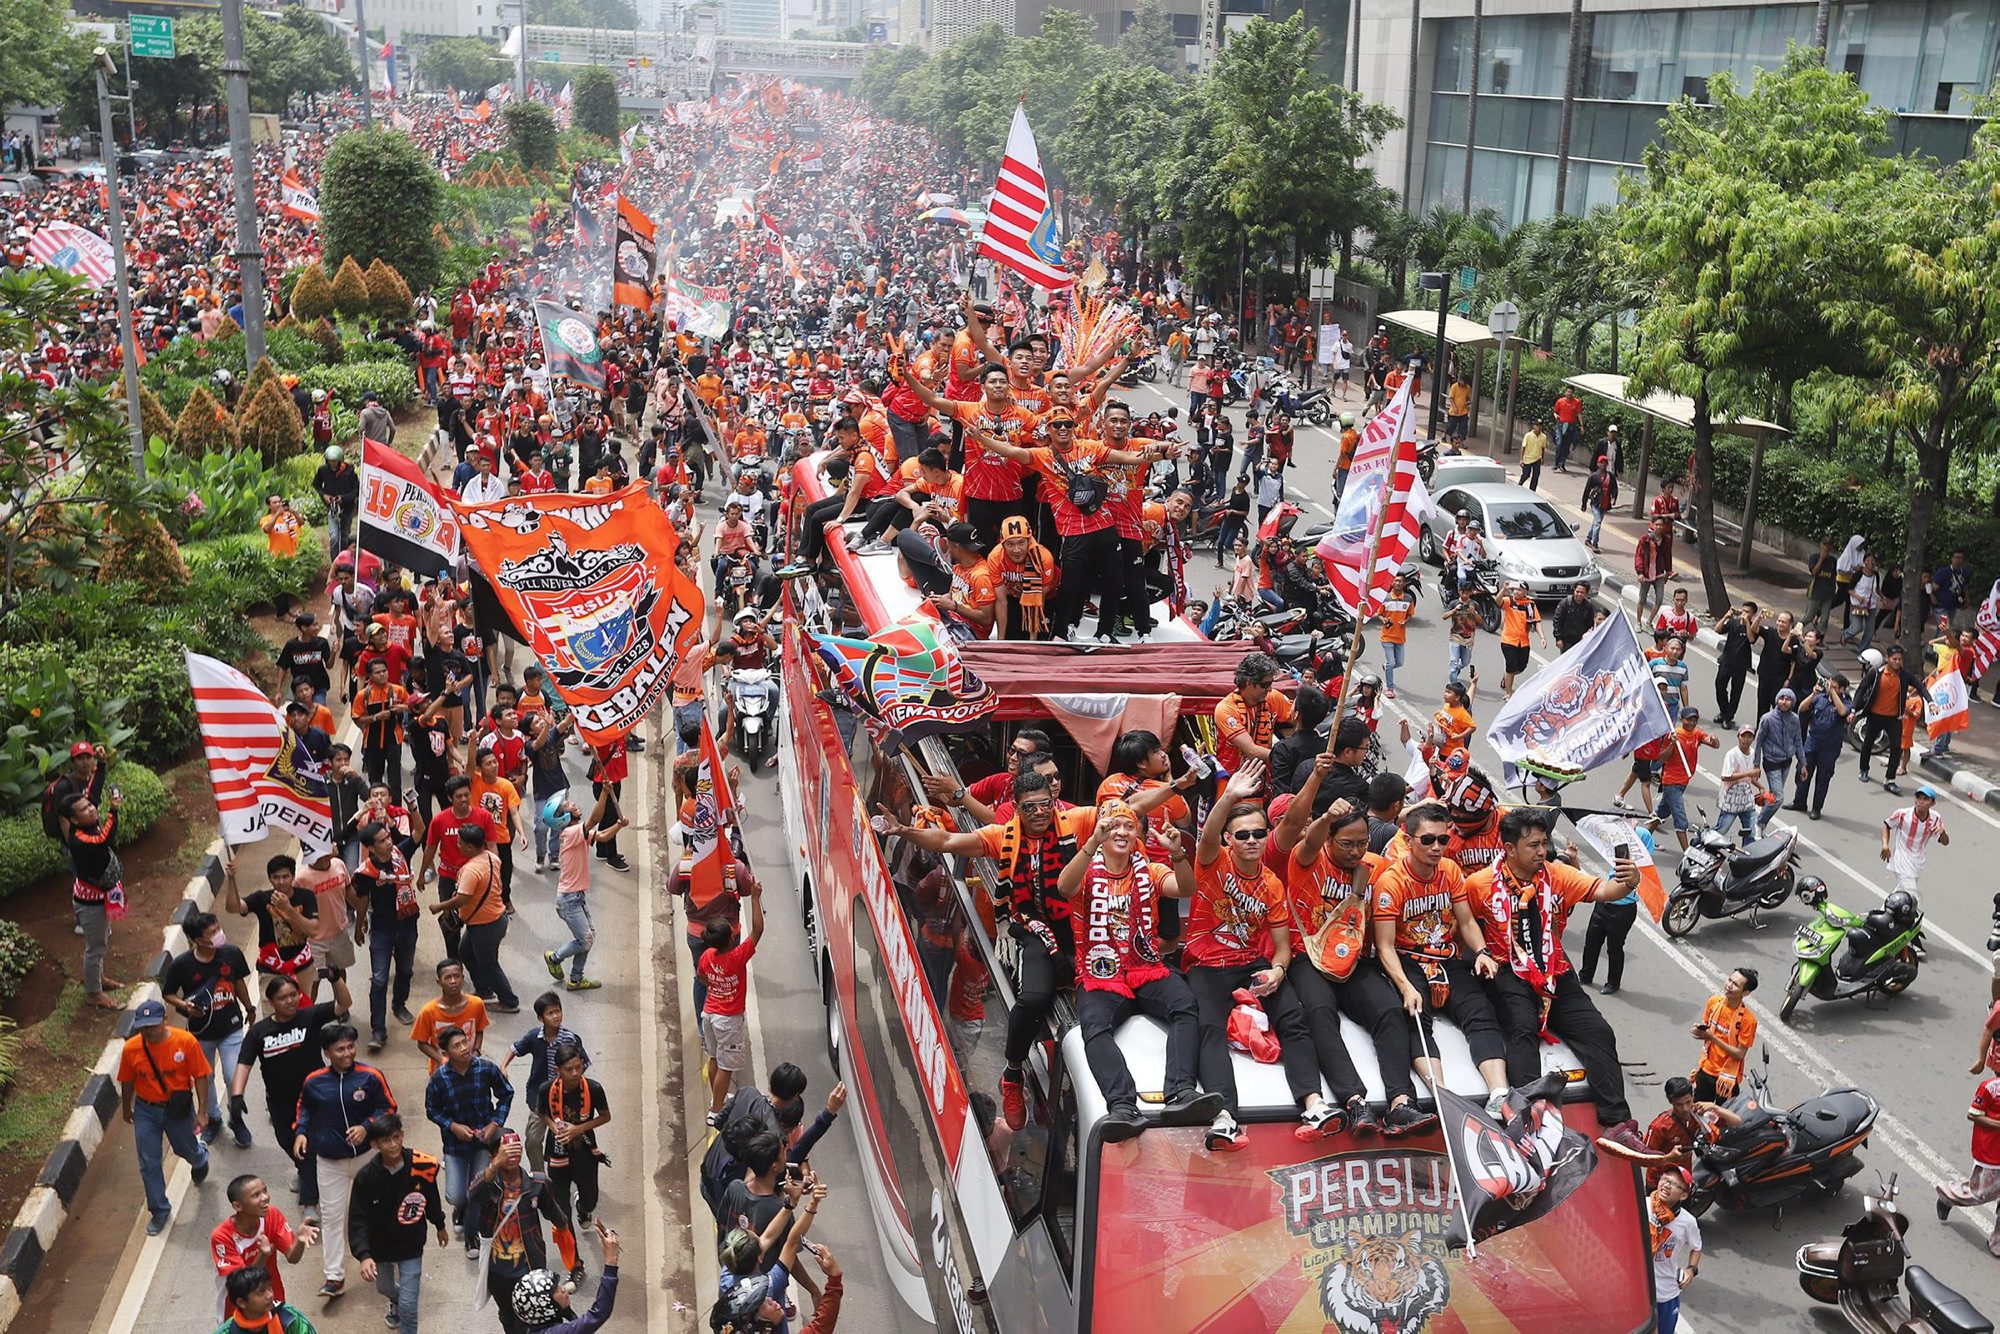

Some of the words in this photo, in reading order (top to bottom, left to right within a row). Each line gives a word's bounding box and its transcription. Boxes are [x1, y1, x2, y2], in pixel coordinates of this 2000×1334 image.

[364, 474, 401, 523] 19
[541, 578, 575, 590] NEVER
[575, 566, 607, 587] WALK
[617, 692, 656, 730] JAKARTA
[263, 1027, 307, 1049] Totally
